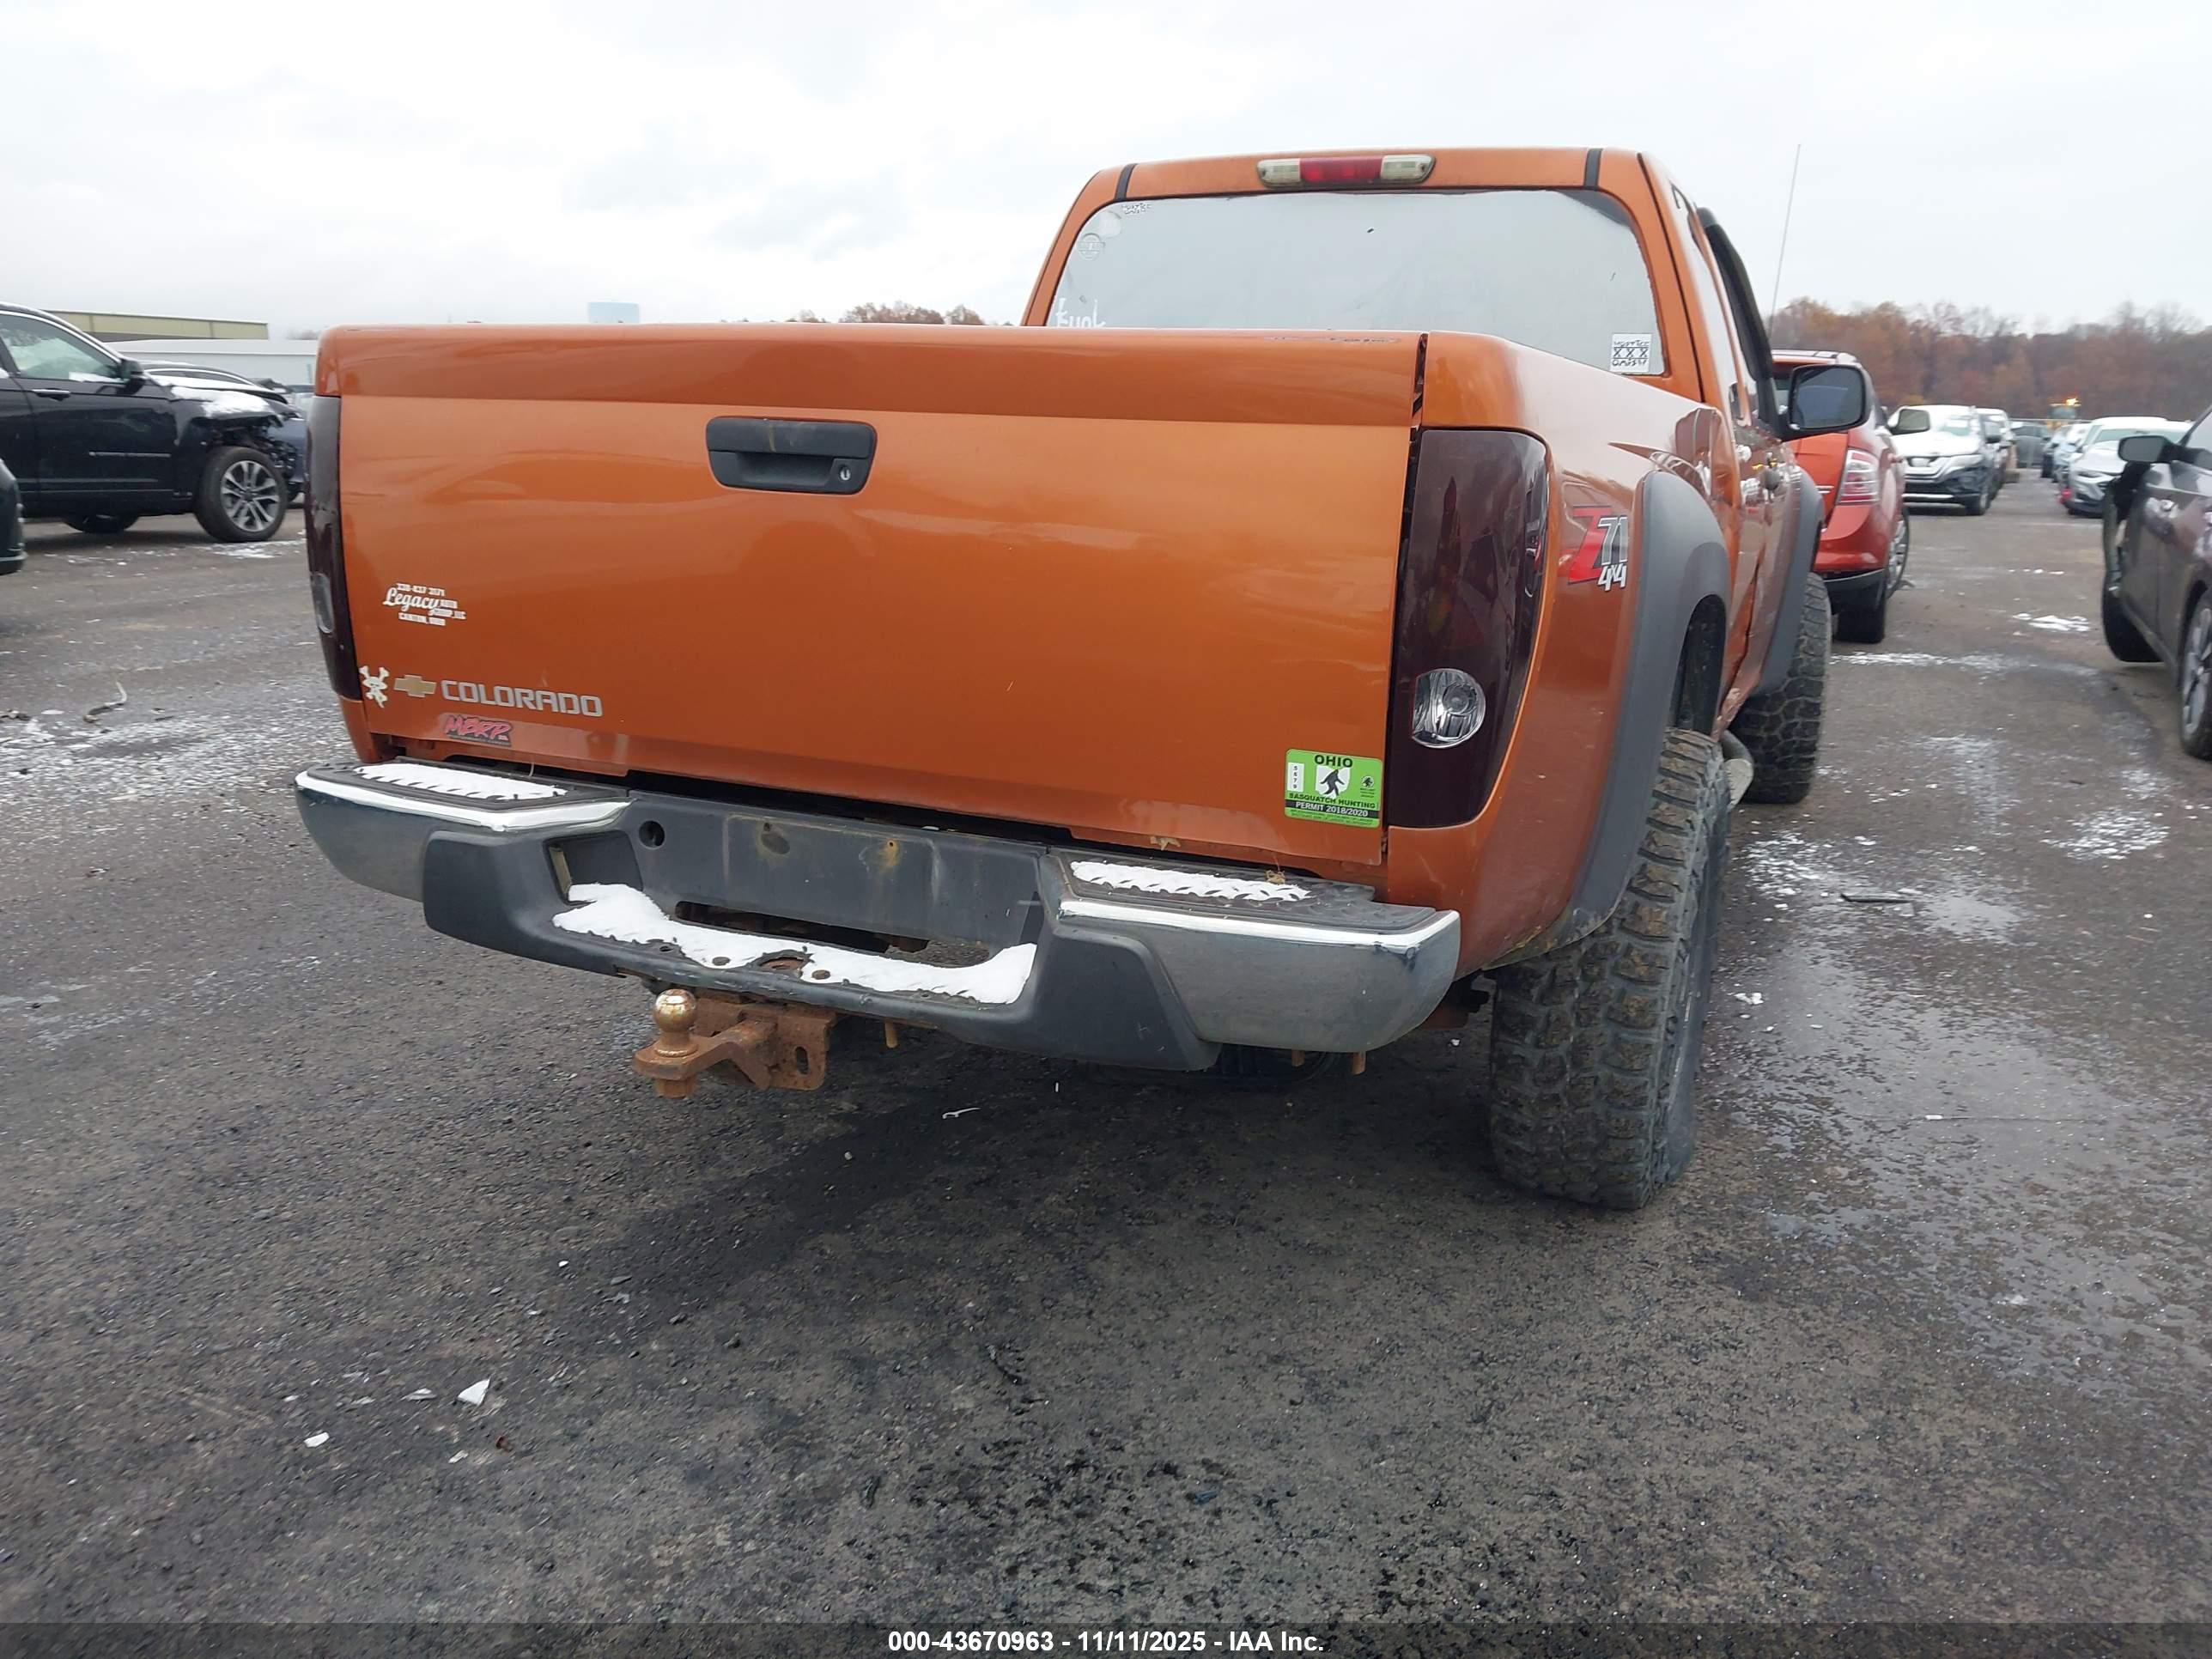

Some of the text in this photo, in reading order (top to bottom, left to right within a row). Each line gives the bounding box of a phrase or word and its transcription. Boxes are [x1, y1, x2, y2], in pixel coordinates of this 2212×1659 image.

[383, 587, 440, 611] Legacy
[441, 680, 603, 717] COLORADO
[1315, 755, 1353, 768] OHIO
[1289, 793, 1376, 809] SASQUATCH HUNTING
[1296, 801, 1369, 817] PERMIT 2018/2020
